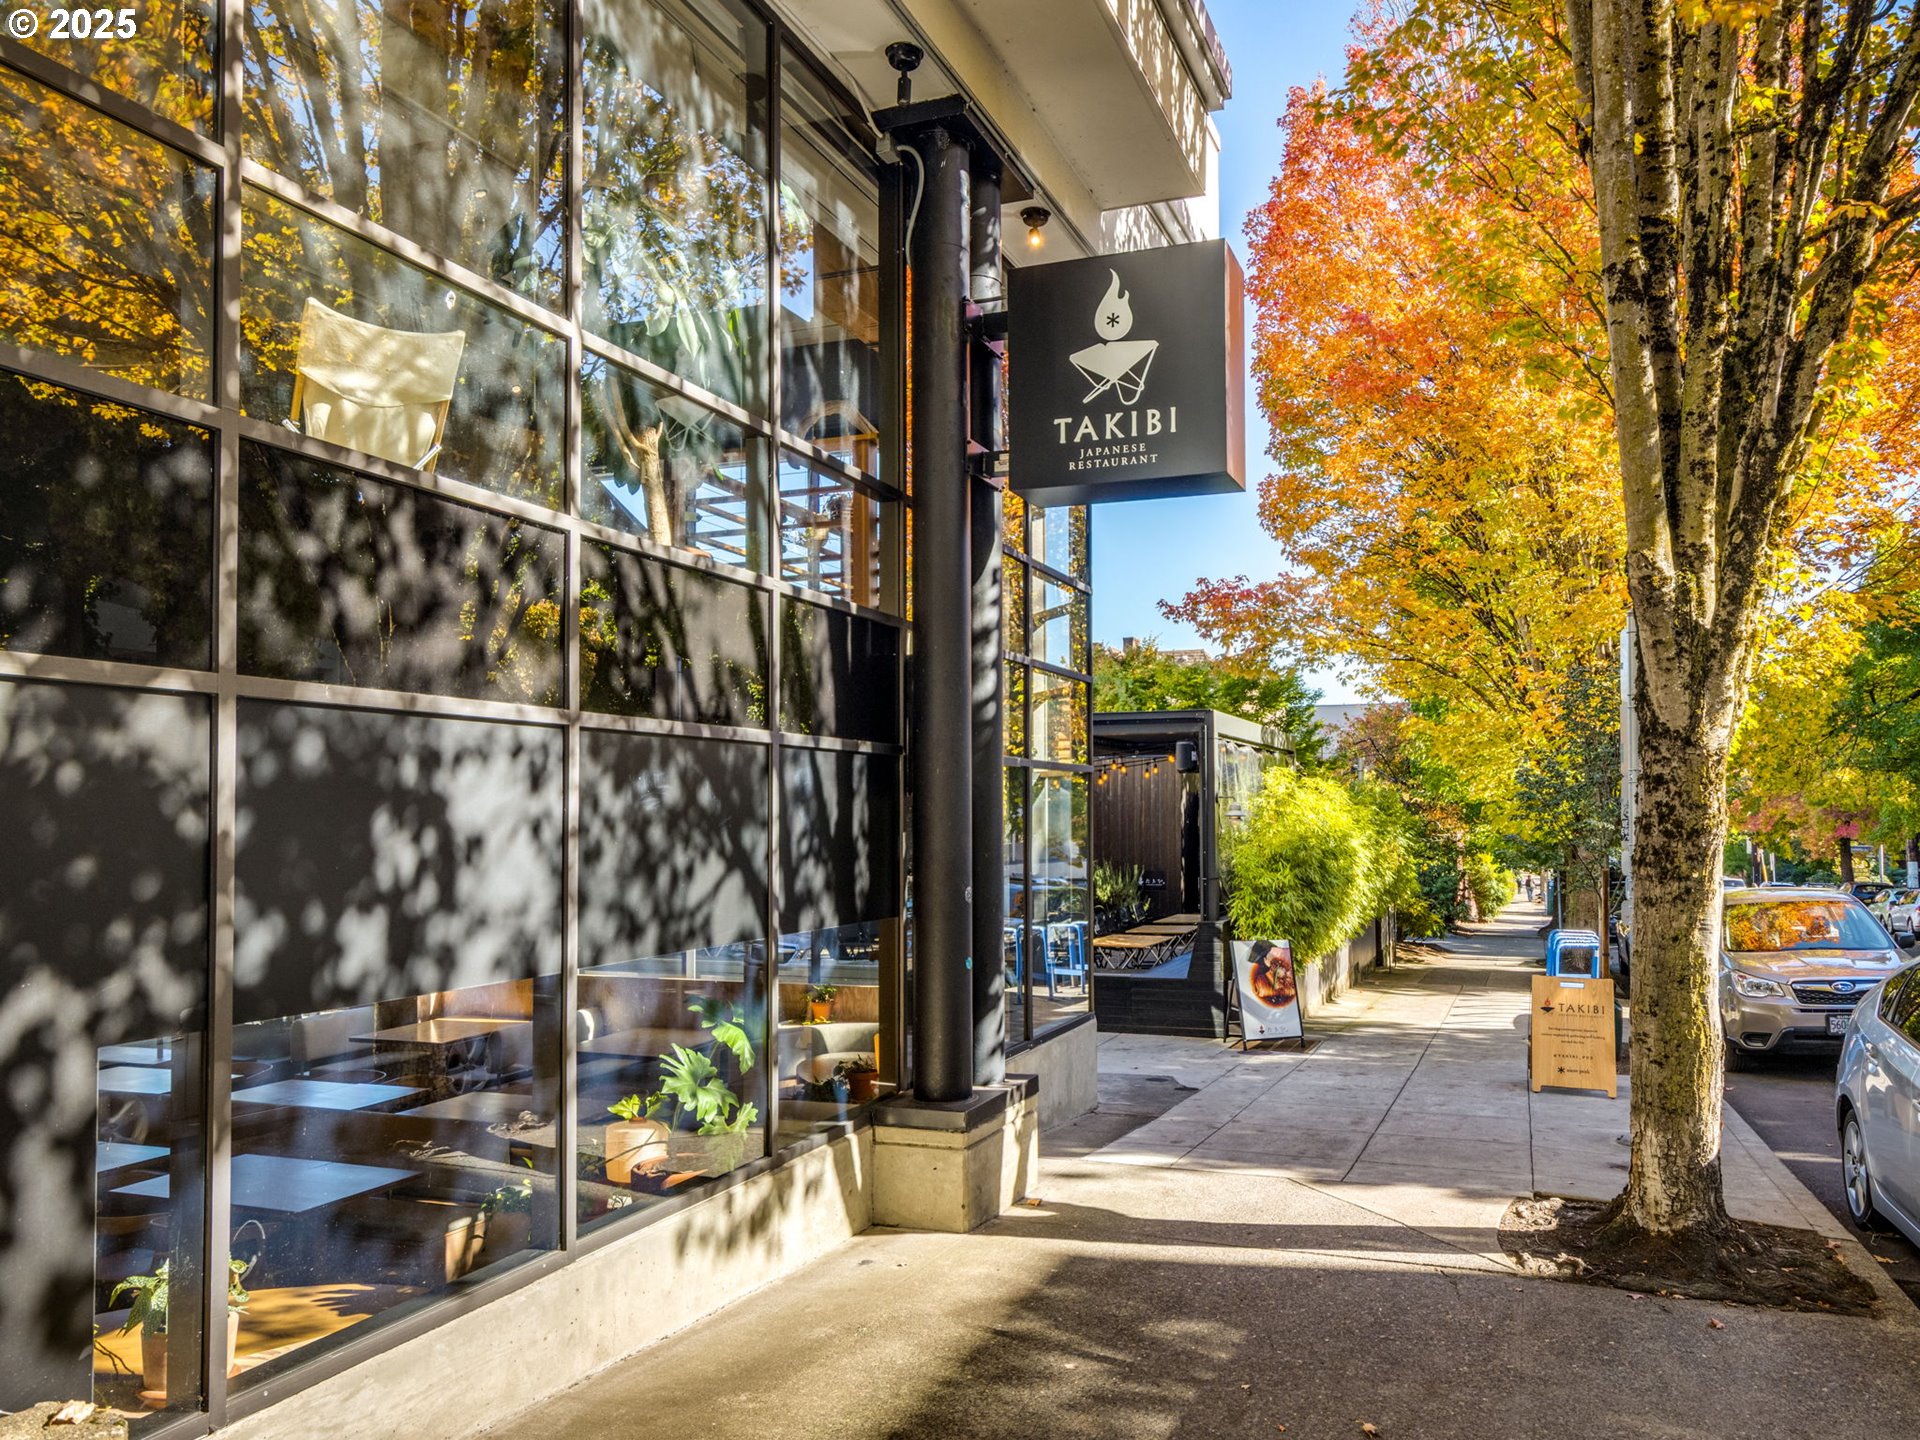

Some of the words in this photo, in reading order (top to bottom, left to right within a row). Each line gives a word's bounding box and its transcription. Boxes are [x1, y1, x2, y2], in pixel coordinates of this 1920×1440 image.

[1053, 406, 1177, 444] TAKIBI
[1079, 443, 1147, 460] JAPANESE
[1068, 453, 1159, 471] RESTAURANT
[1558, 1003, 1605, 1015] TAKIBI
